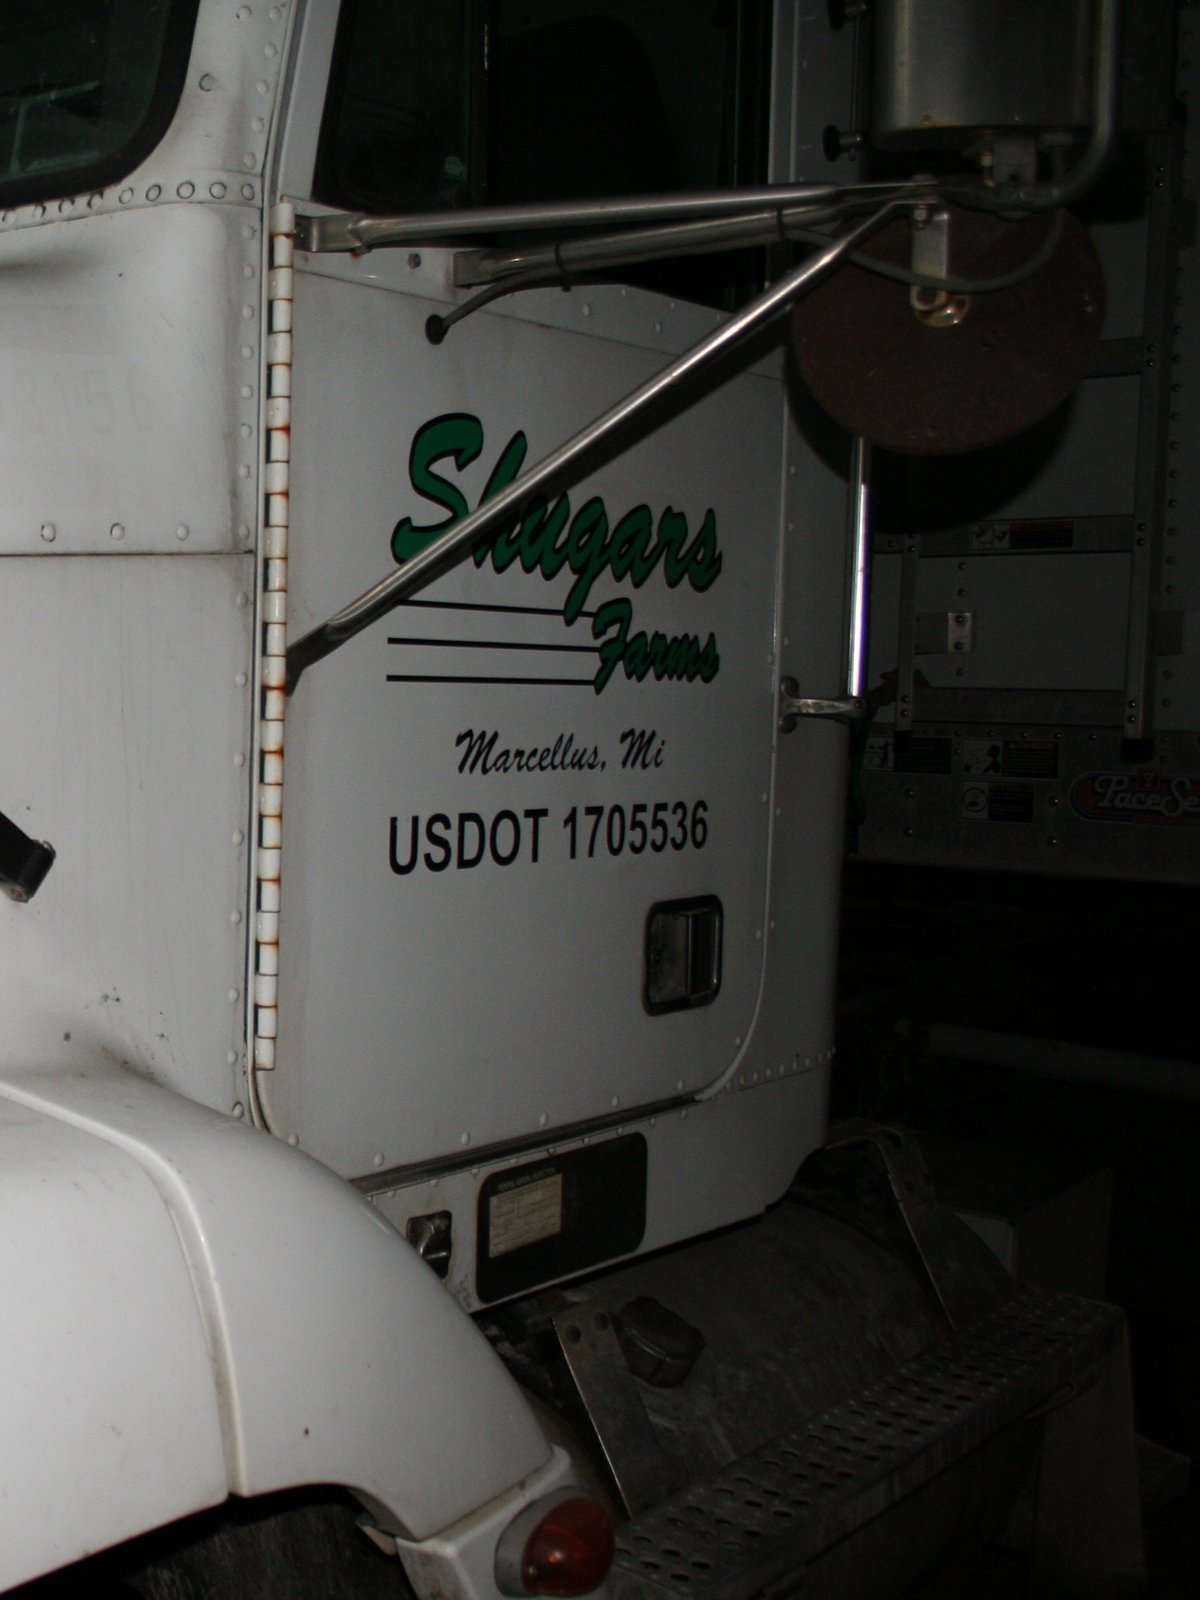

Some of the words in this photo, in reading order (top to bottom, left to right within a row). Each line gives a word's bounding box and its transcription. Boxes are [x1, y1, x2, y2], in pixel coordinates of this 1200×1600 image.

[593, 598, 719, 694] Farms
[455, 729, 607, 775] Marcellus,
[620, 729, 665, 770] Mi
[389, 808, 548, 875] USDOT
[563, 800, 708, 859] 1705536
